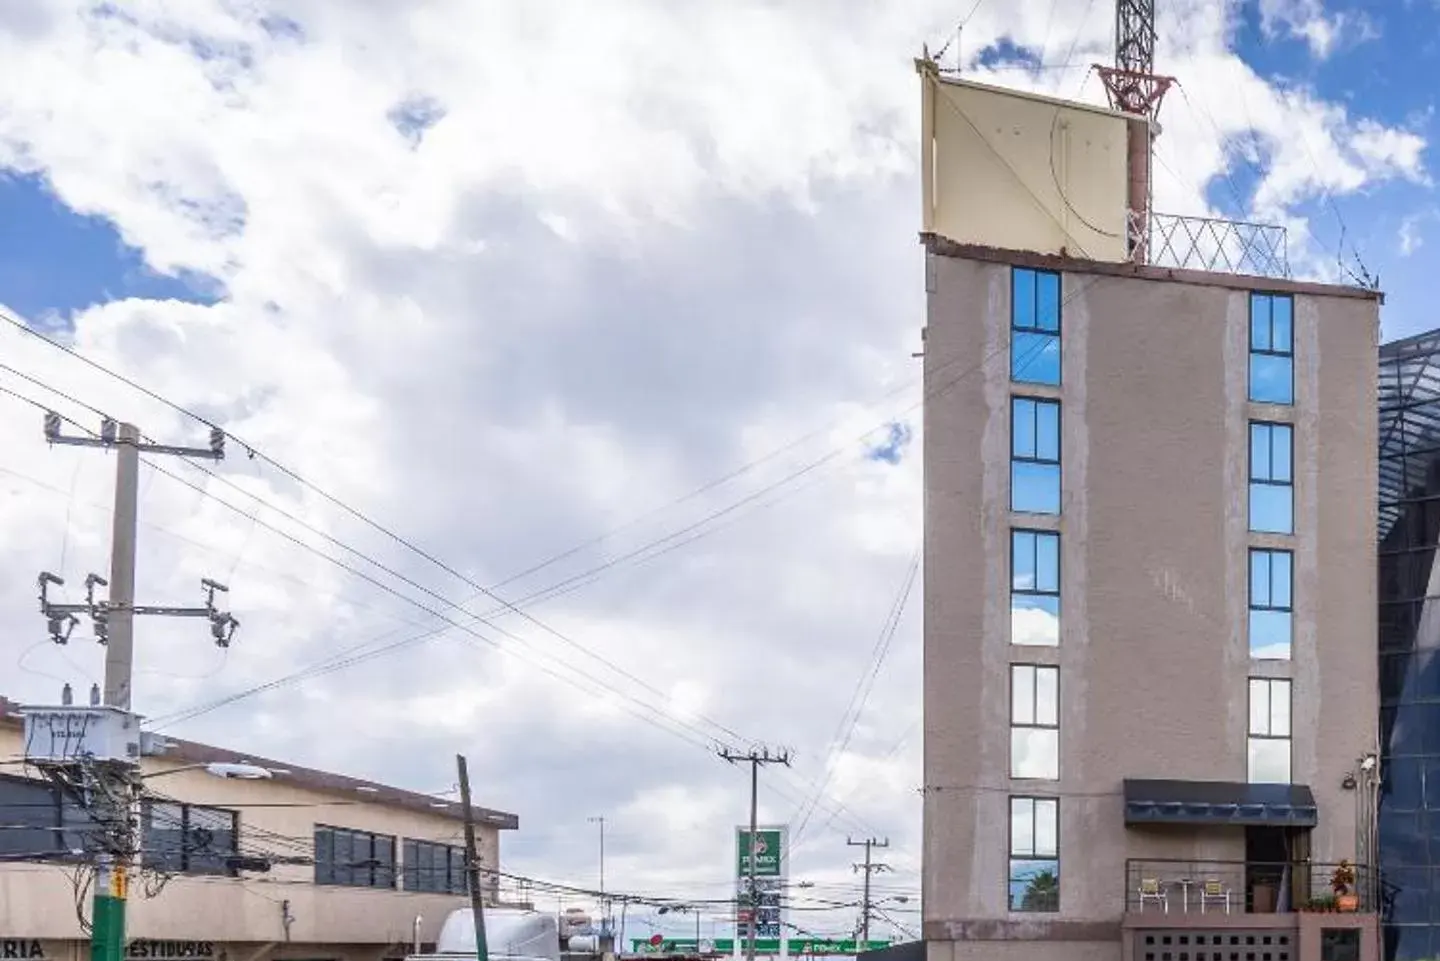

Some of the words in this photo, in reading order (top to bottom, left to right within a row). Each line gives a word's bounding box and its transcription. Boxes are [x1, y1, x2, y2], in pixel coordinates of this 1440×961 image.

[742, 855, 777, 863] PMEX
[0, 938, 45, 959] RIA
[125, 939, 215, 959] ESTIDURAS
